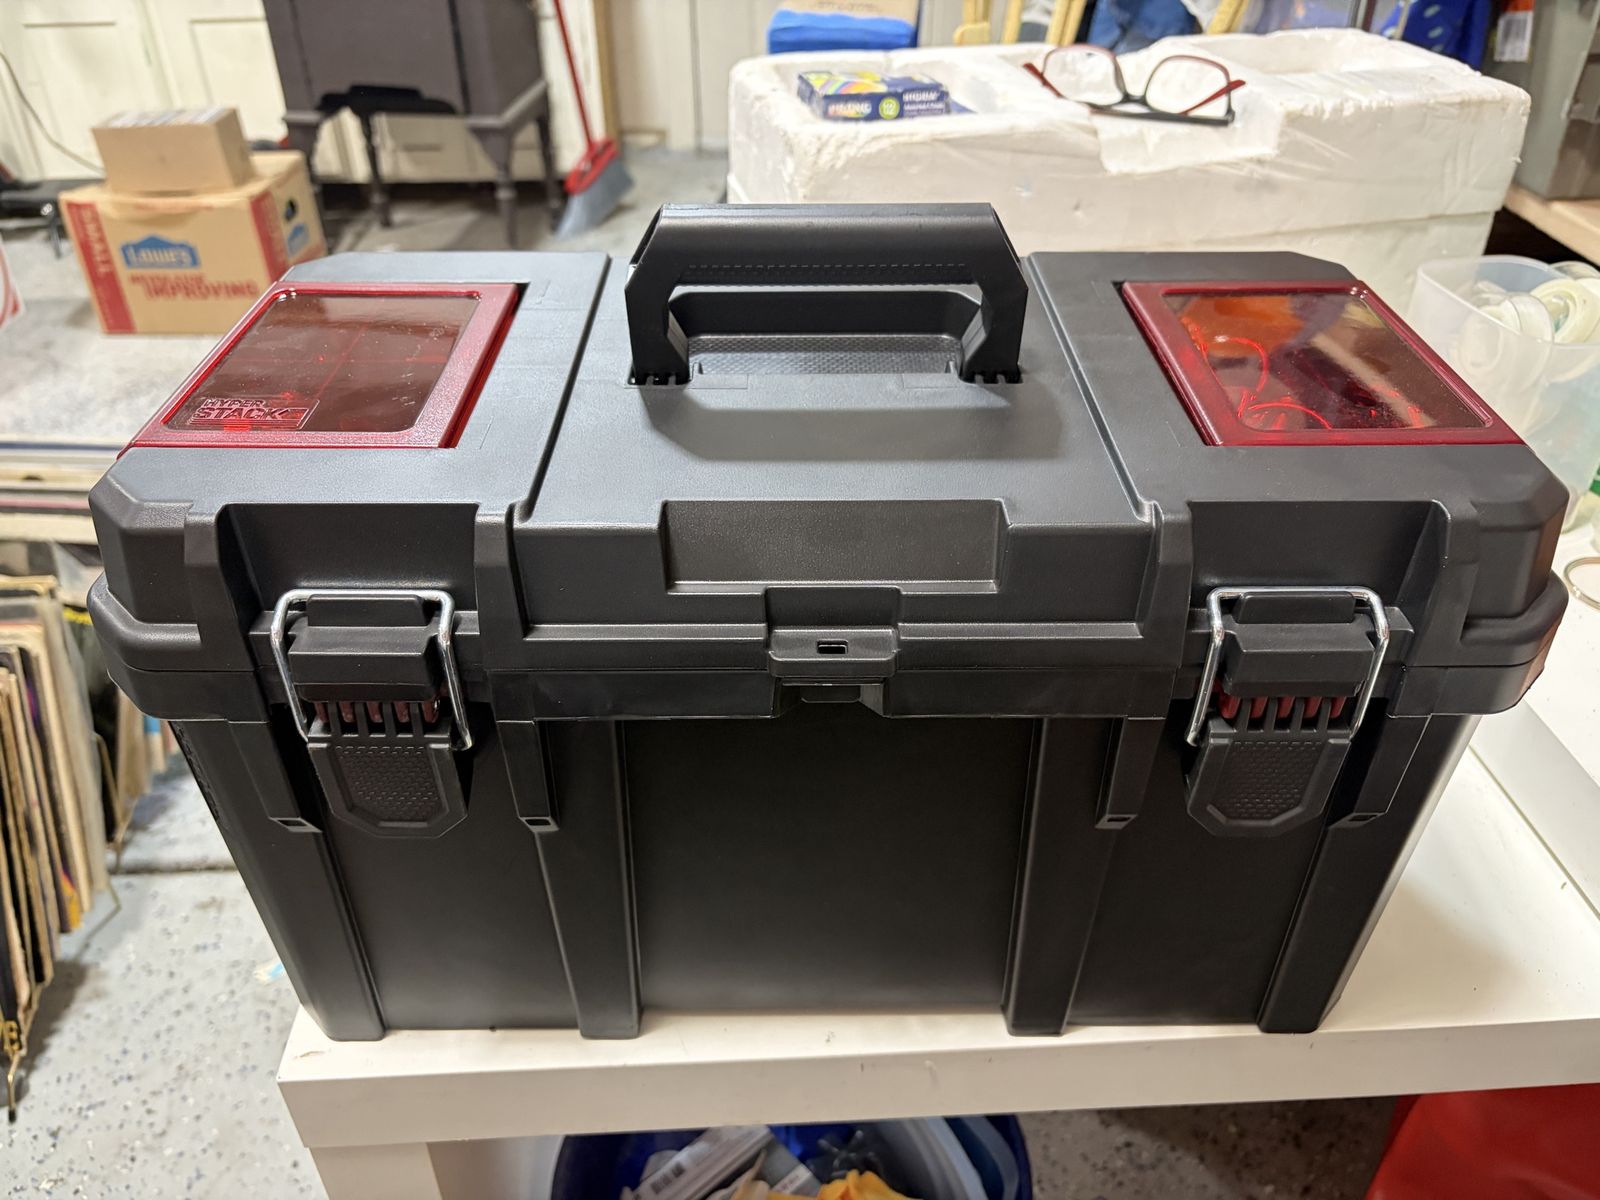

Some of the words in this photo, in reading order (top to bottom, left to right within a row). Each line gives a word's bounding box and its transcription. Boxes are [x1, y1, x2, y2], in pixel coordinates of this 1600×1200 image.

[145, 278, 259, 299] IMPROVING
[203, 399, 265, 408] HYPER
[194, 407, 289, 419] STACK
